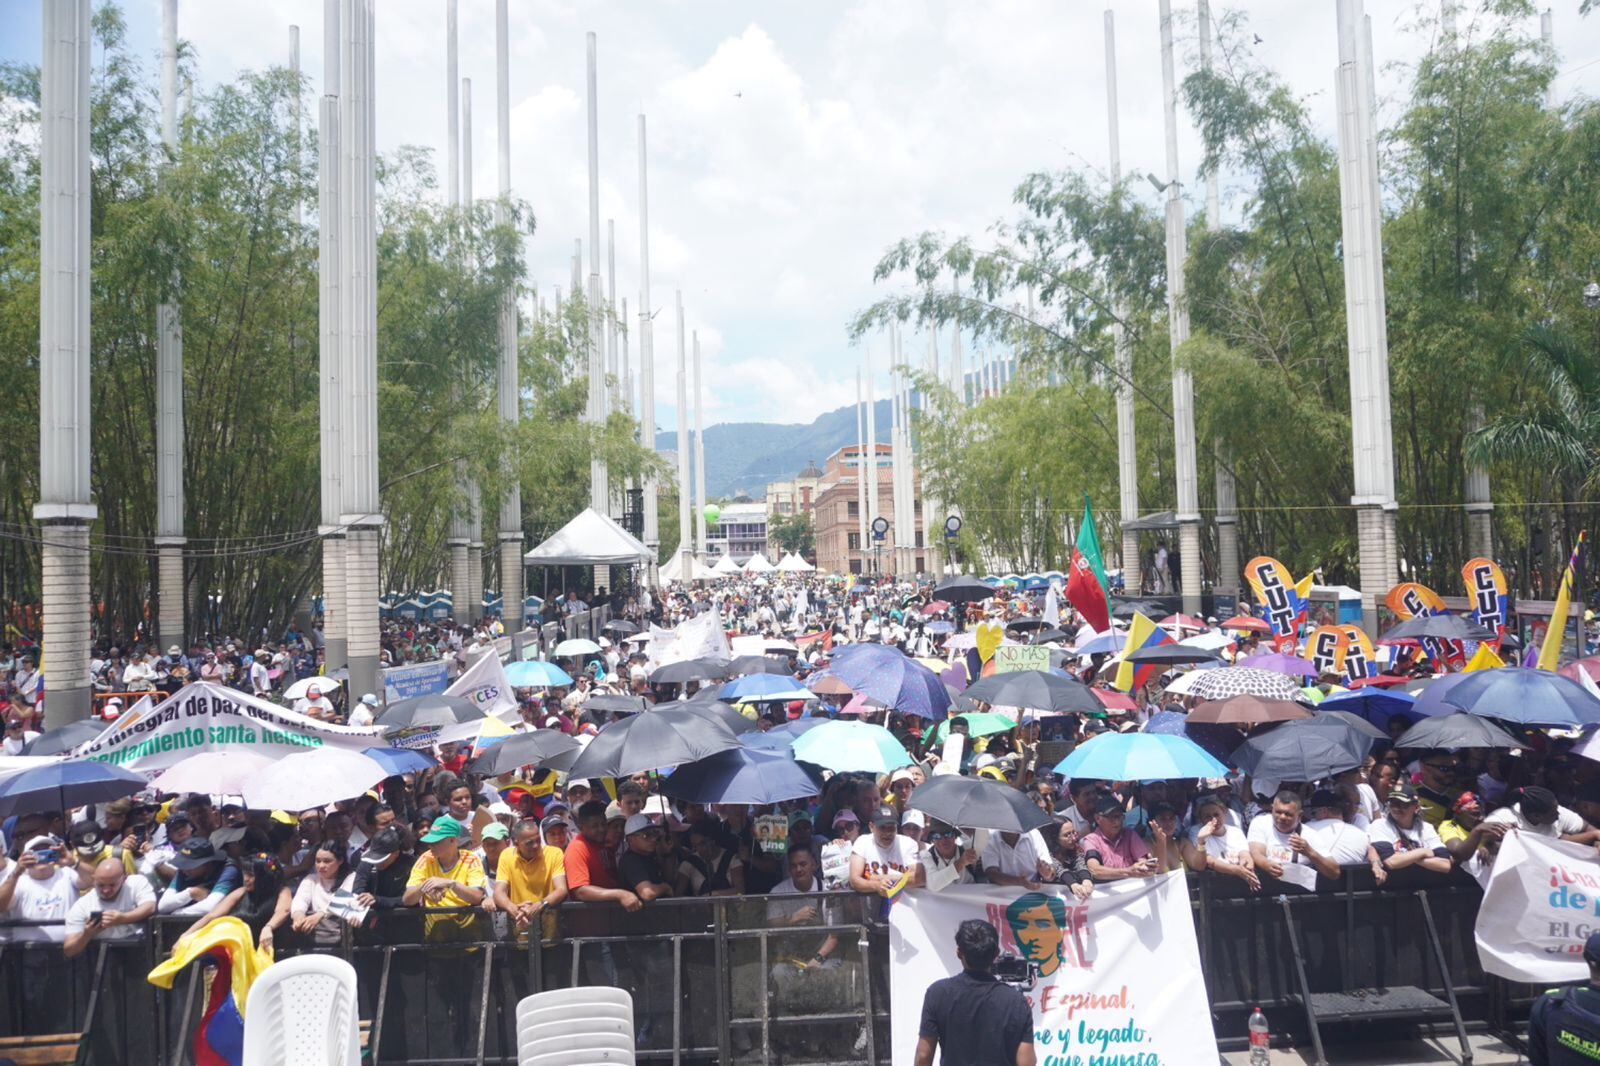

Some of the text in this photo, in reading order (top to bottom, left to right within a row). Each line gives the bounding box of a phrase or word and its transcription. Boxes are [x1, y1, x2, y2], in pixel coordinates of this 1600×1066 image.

[1256, 562, 1295, 637] CUT
[1474, 565, 1501, 635] CUT
[1001, 646, 1018, 661] NO
[186, 696, 207, 716] de
[212, 696, 242, 717] paz
[209, 724, 256, 744] santa
[1549, 885, 1587, 910] de
[1548, 921, 1569, 938] El
[1058, 1028, 1070, 1054] y
